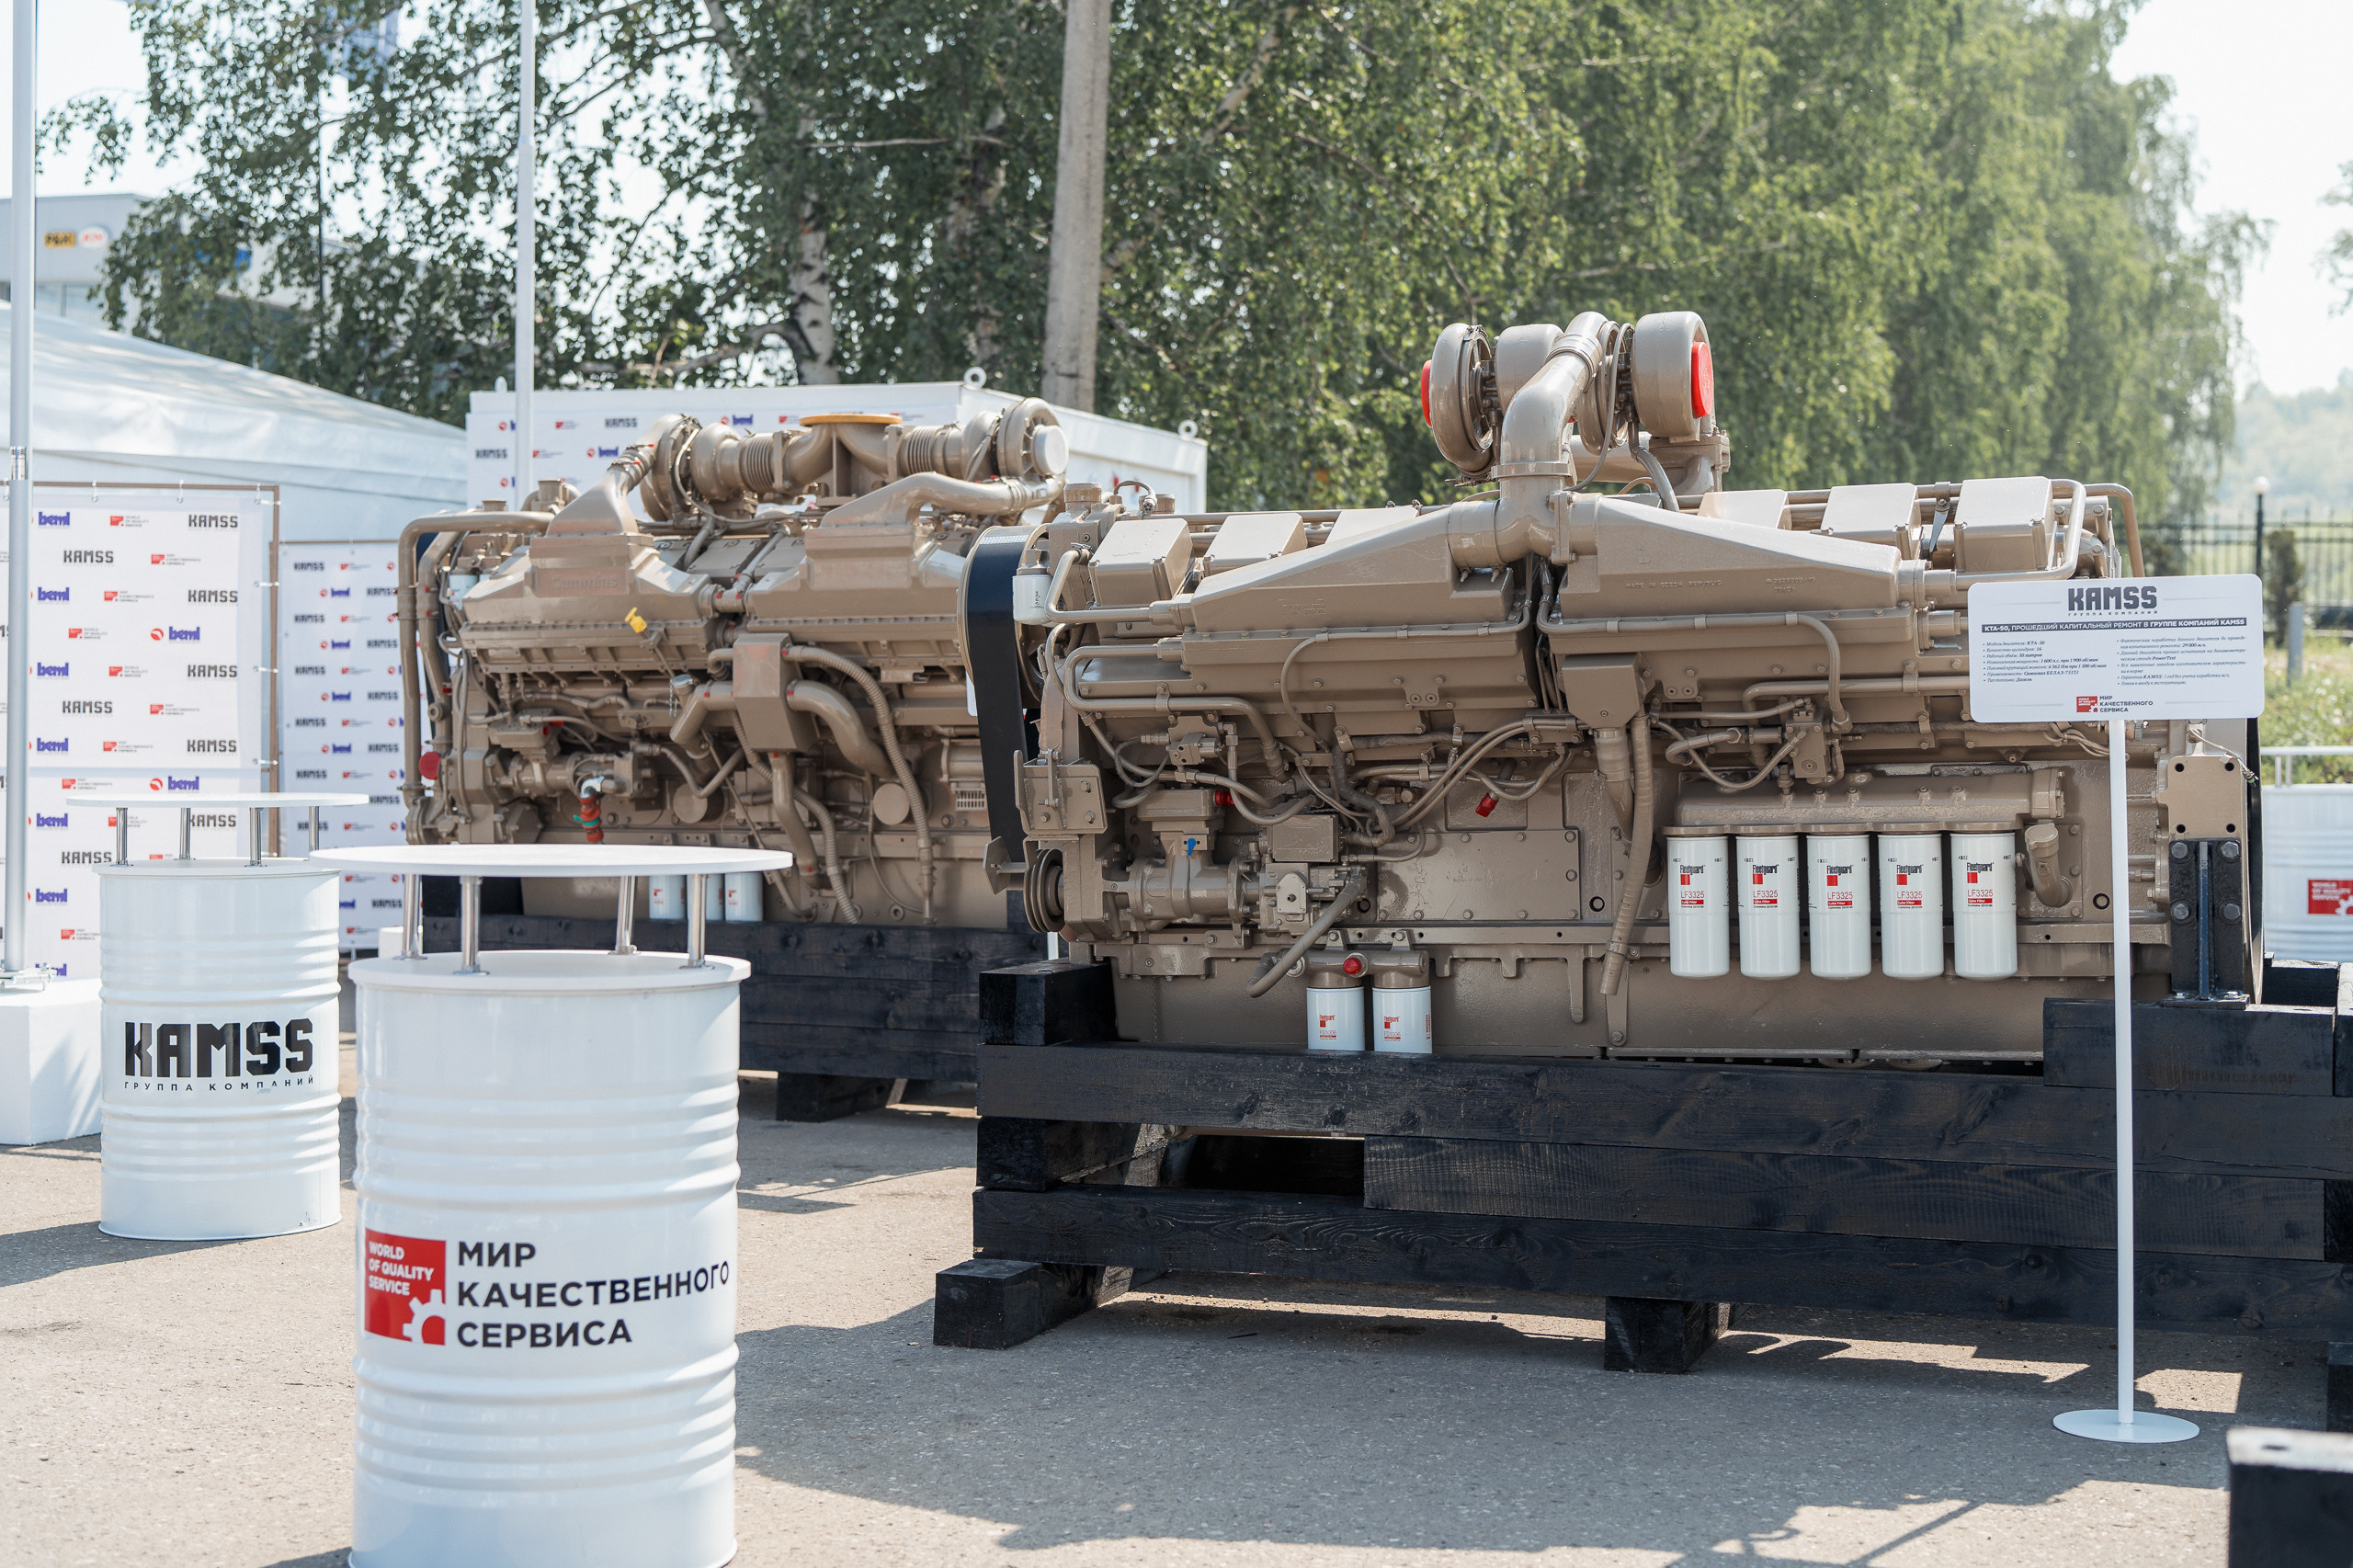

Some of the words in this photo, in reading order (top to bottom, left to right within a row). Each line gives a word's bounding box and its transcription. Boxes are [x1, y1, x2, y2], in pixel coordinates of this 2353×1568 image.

[188, 515, 238, 528] KAMSS
[63, 550, 114, 563] KAMSS
[188, 590, 238, 602] KAMSS
[2068, 586, 2157, 611] KAMSS
[2178, 618, 2219, 627] КОМПАНИЙ
[187, 665, 238, 677] KAMSS
[62, 701, 113, 714] KAMSS
[187, 739, 237, 753] KAMSS
[189, 815, 237, 827] KAMSS
[62, 852, 112, 864] KAMSS
[1680, 865, 1704, 875] Fleetguard
[1752, 864, 1777, 875] Fleetguard
[1827, 865, 1852, 876] Fleetguard
[1897, 864, 1922, 875] Fleetguard
[1967, 863, 1992, 873] Fleetguard
[125, 1018, 313, 1078] KAMSS
[125, 1082, 193, 1091] ГРУППА
[209, 1075, 313, 1091] КОМПАНИЙ
[369, 1241, 405, 1261] WORLD
[458, 1241, 536, 1267] МИР
[369, 1258, 381, 1272] OF
[381, 1261, 435, 1282] QUALITY
[369, 1275, 410, 1297] SERVICE
[458, 1261, 729, 1308] КАЧЕСТВЕННОГО
[457, 1319, 632, 1348] СЕРВИСА
